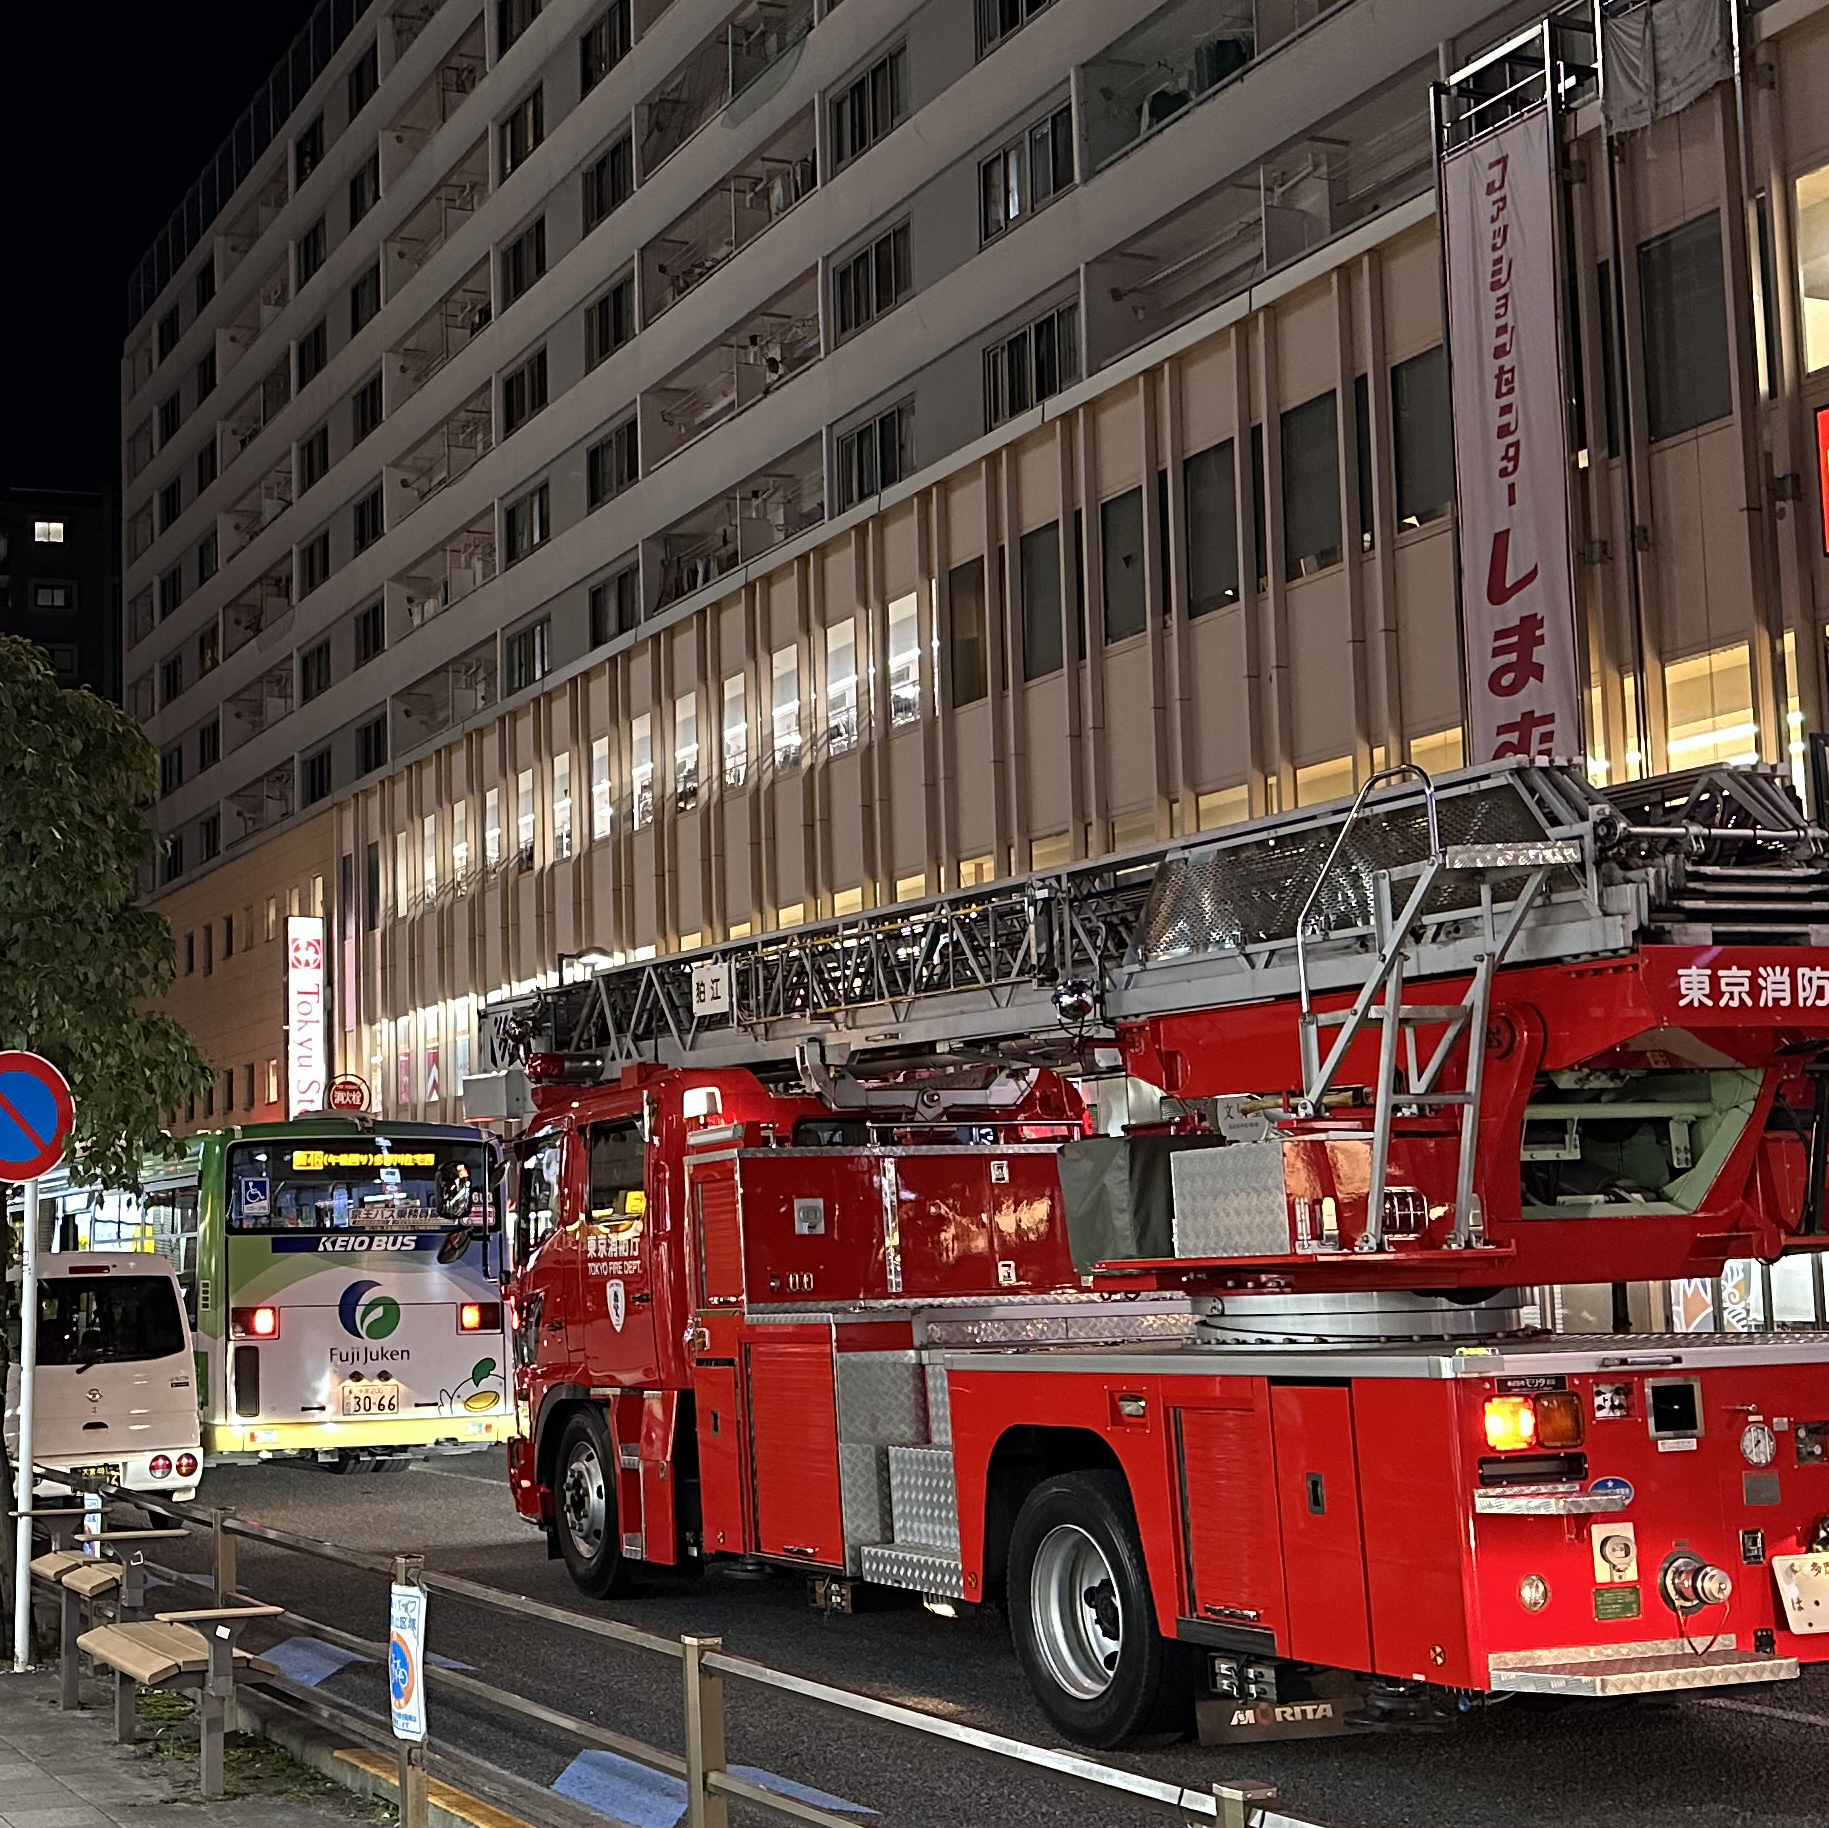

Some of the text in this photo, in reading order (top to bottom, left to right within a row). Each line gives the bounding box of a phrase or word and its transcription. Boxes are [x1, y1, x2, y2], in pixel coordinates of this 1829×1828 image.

[1485, 153, 1521, 508] ファッションセンター
[695, 977, 722, 1004] 狛江
[1676, 965, 1829, 1008] 東京消防
[294, 983, 321, 1113] Tokyu St
[333, 1090, 362, 1105] 消火栓
[317, 1235, 418, 1252] KEIO BUS
[587, 1261, 608, 1276] TOKYO
[608, 1260, 623, 1275] FIRE
[329, 1345, 411, 1366] Fuji Juken
[1789, 1596, 1805, 1612] は
[1229, 1702, 1334, 1726] MORITA
